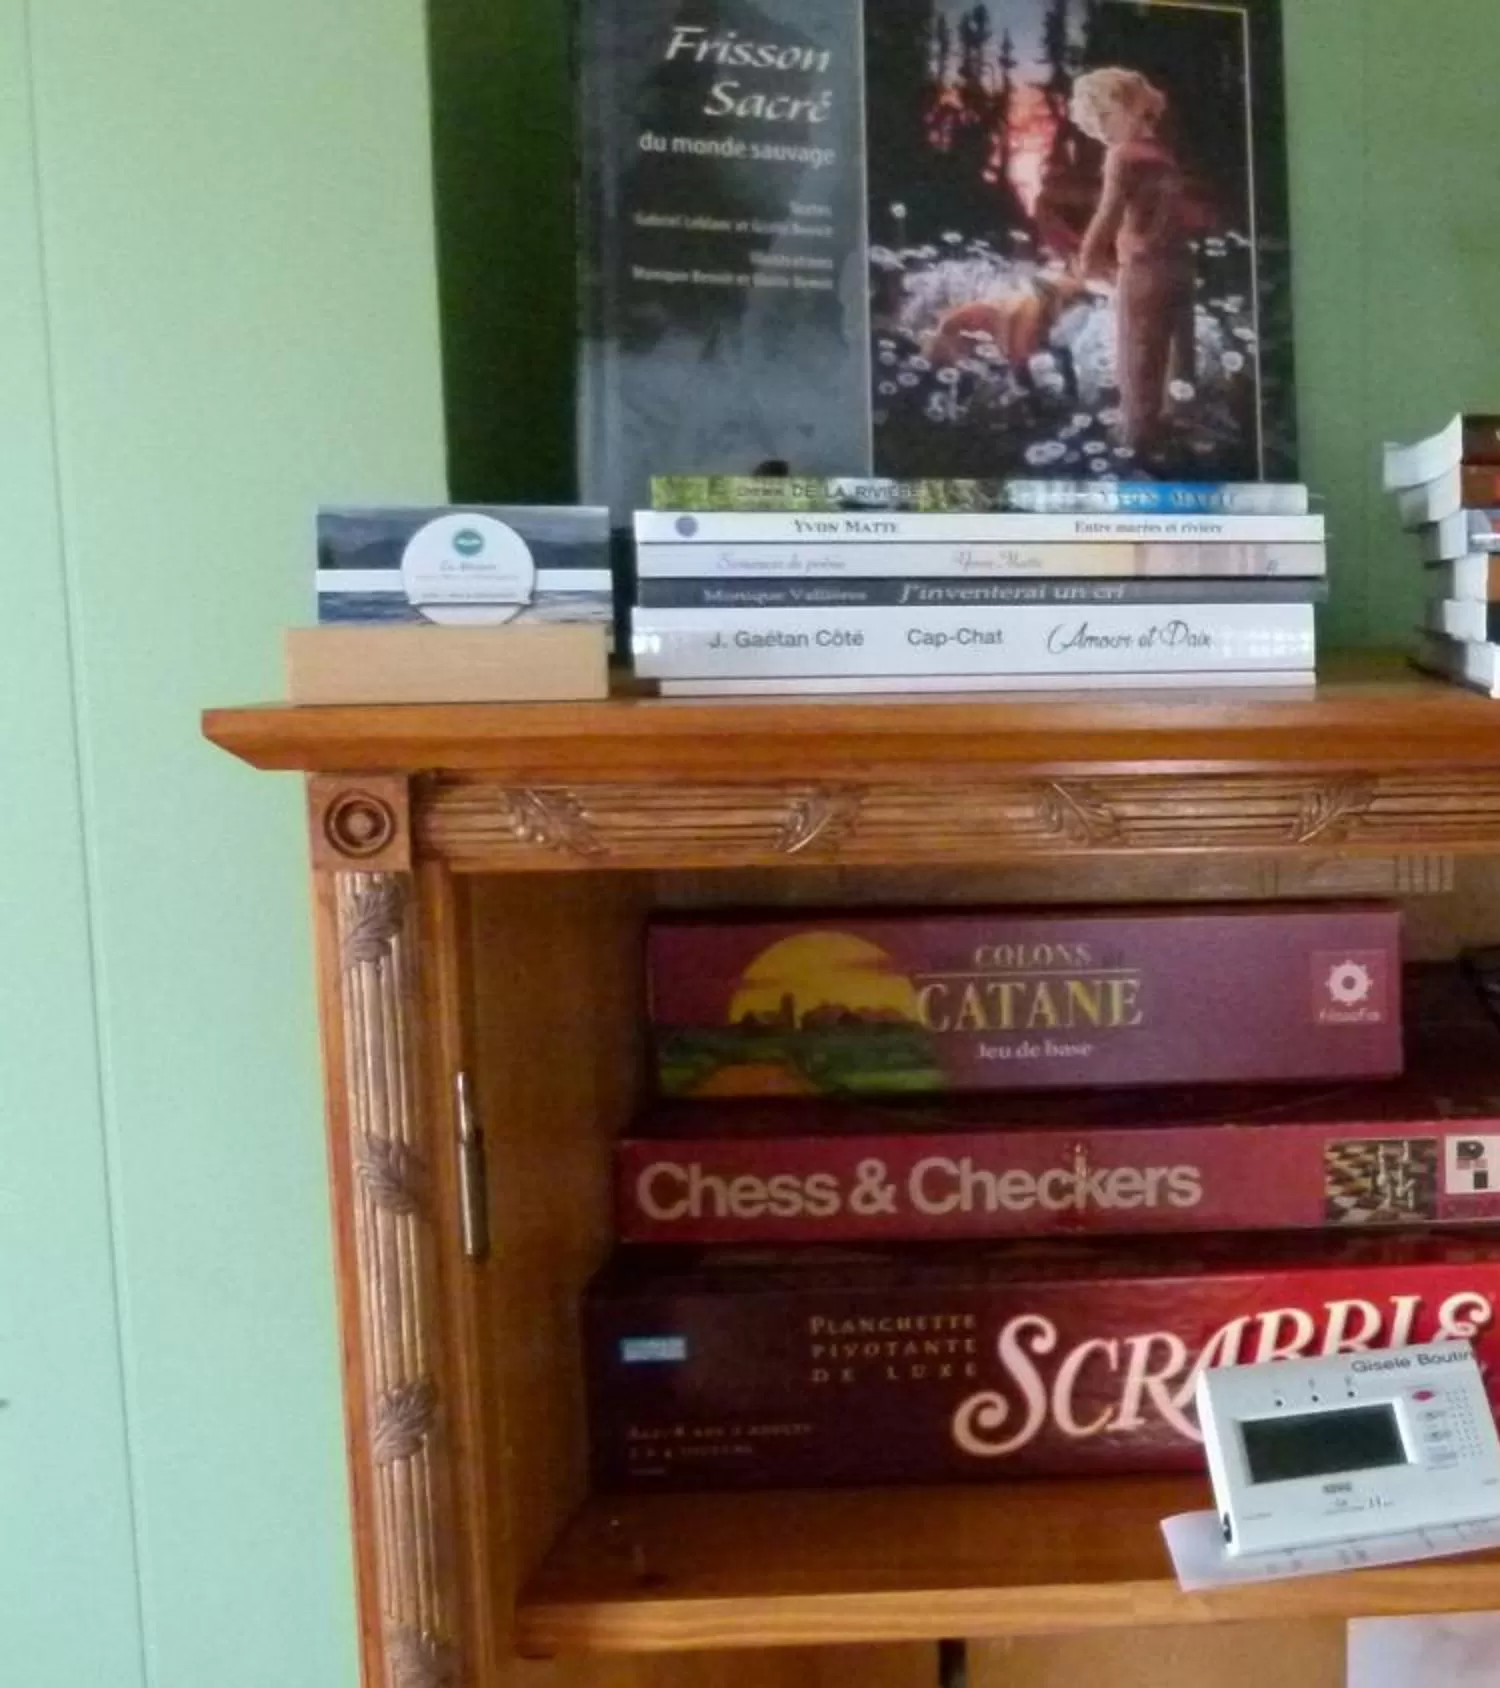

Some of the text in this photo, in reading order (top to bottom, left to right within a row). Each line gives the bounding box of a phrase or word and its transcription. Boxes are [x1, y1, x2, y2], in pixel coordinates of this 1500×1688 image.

[664, 24, 830, 73] Frisson
[703, 79, 833, 124] Sacré
[639, 130, 836, 169] du monde sauvage
[708, 632, 728, 650] J.
[815, 627, 865, 648] Côté
[905, 626, 1006, 649] Cap-Chat
[917, 979, 1144, 1033] CATANE
[636, 1155, 1203, 1221] Chess & Checkers
